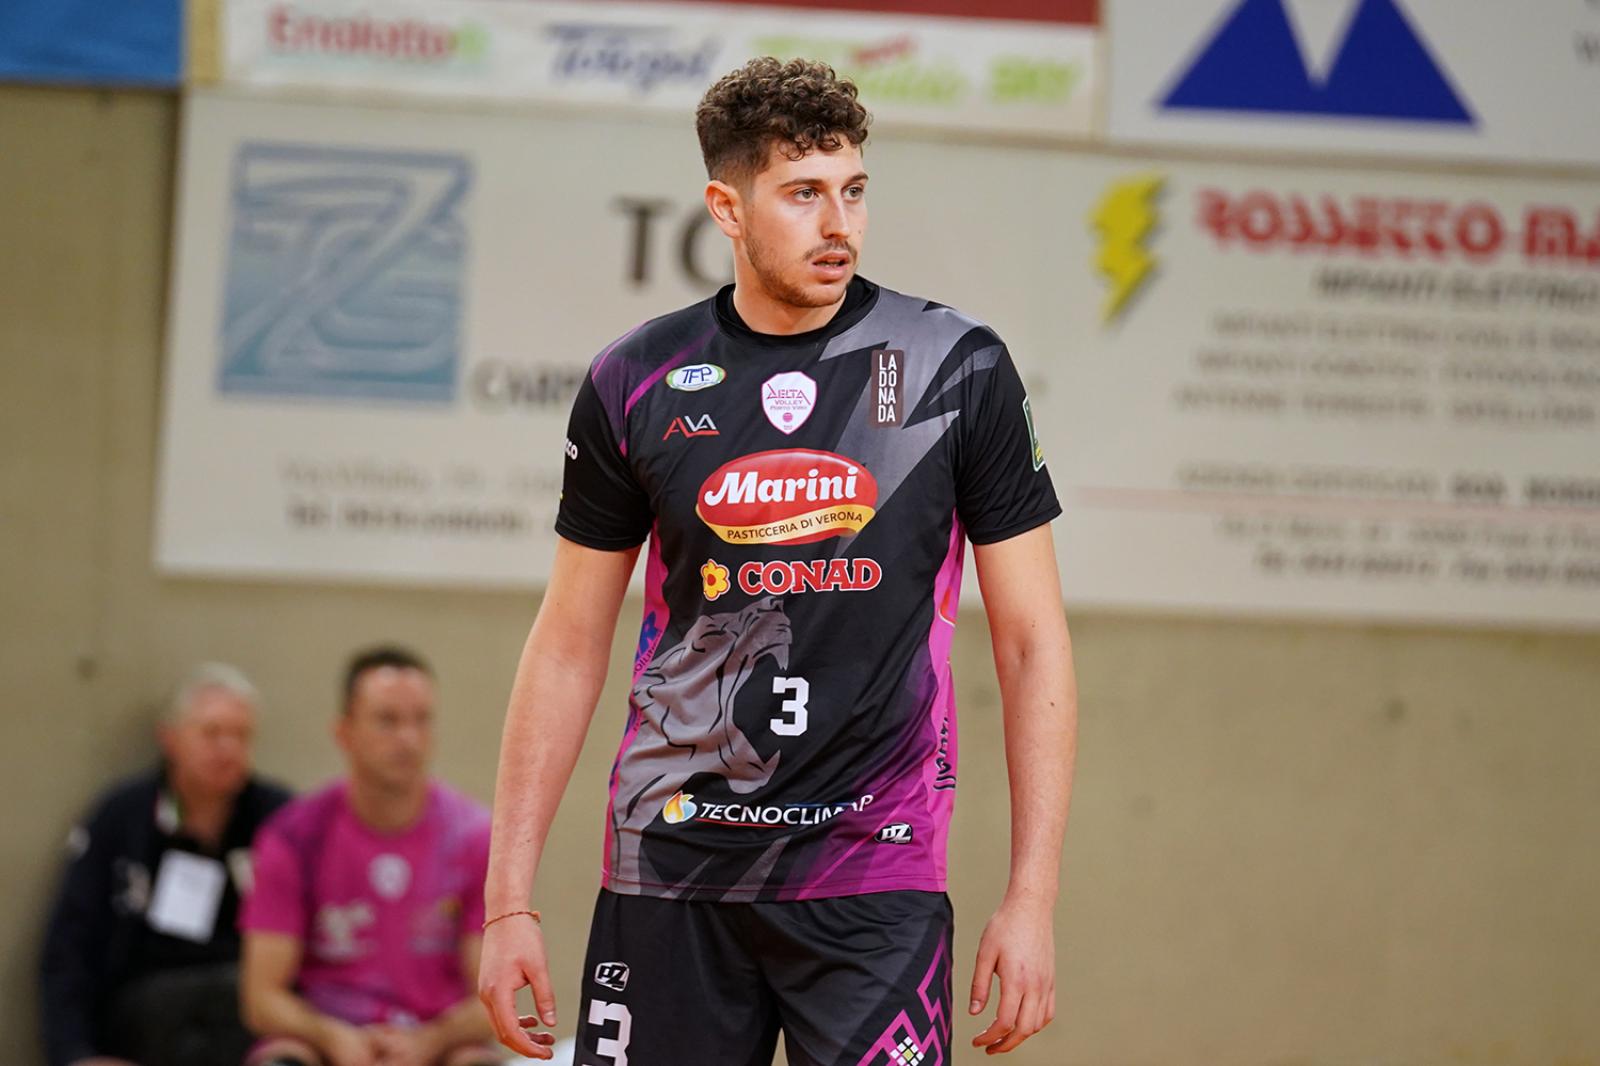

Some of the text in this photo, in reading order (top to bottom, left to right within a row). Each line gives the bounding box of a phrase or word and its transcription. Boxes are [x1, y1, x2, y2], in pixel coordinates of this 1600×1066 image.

[879, 354, 897, 371] LA
[682, 366, 712, 384] TFP
[878, 370, 897, 388] DO
[878, 387, 896, 405] NA
[877, 404, 896, 423] DA
[704, 468, 859, 507] Marini
[727, 511, 863, 540] PASTICCERIA DI VERONA
[737, 557, 883, 596] CONAD
[769, 676, 810, 737] 3
[588, 999, 632, 1066] 3
